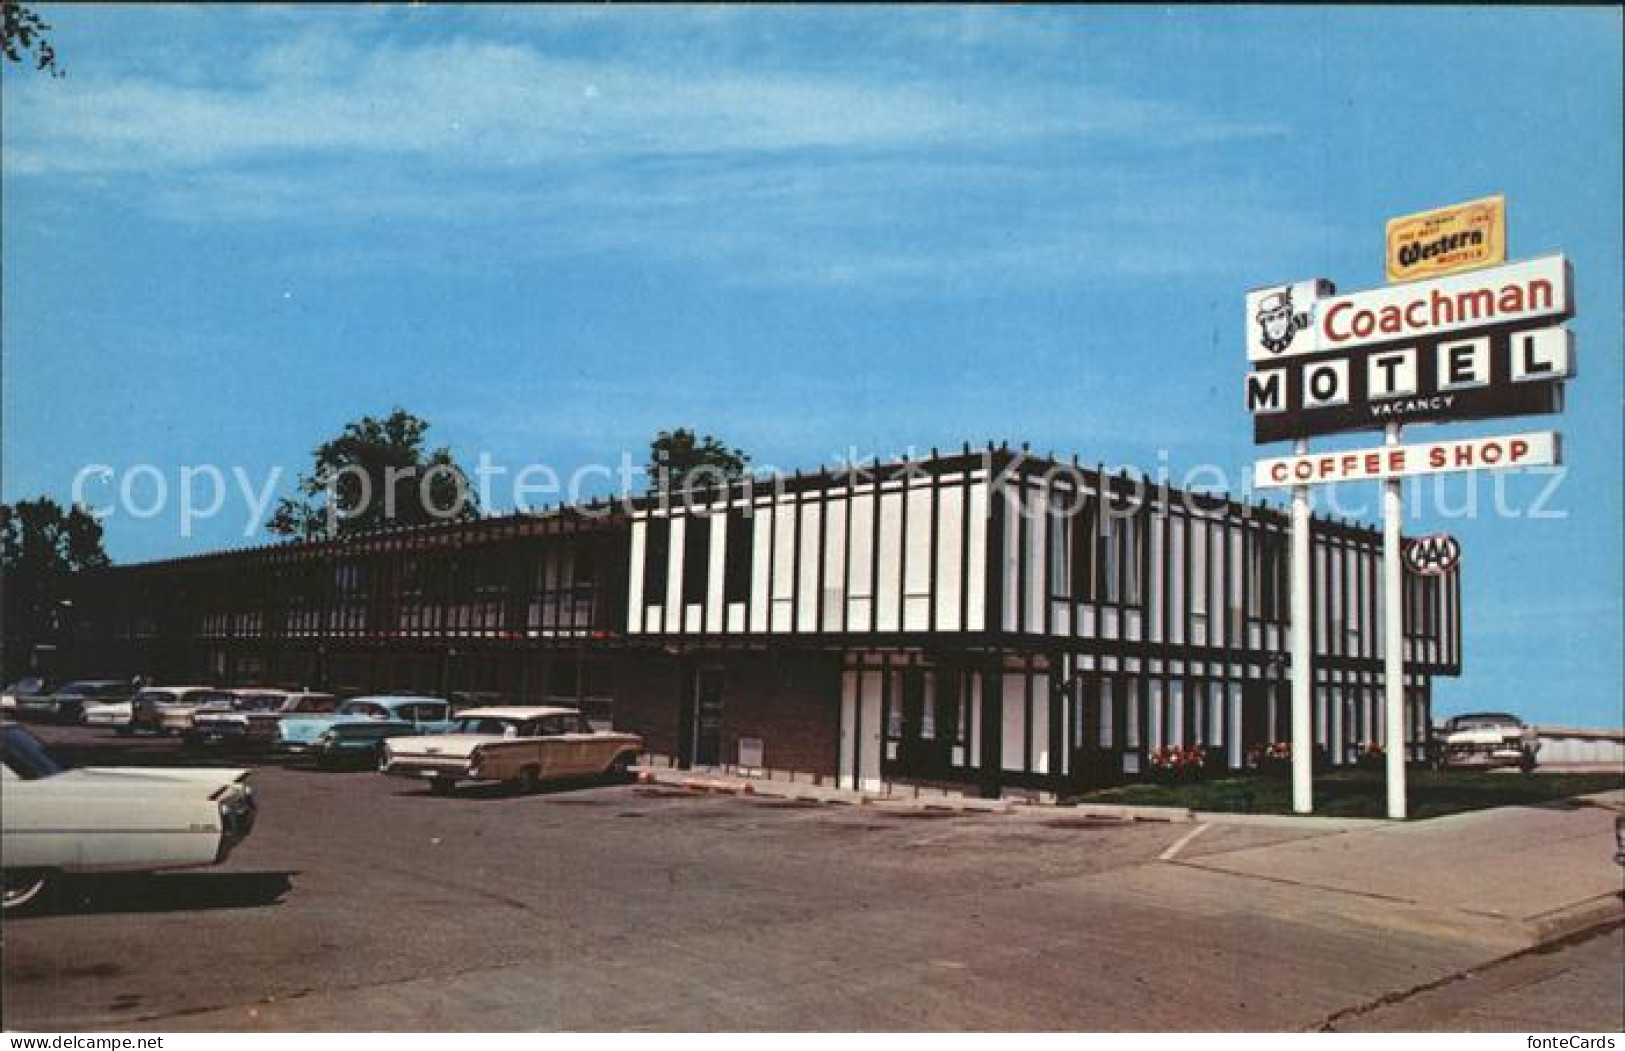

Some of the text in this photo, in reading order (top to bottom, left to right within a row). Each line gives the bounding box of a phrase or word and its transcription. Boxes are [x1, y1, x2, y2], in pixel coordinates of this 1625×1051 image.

[1399, 229, 1483, 268] Western
[1323, 278, 1553, 342] Coachman
[1248, 335, 1552, 412] MOTEL
[1370, 395, 1455, 416] VACANCY
[1271, 440, 1529, 482] COFFEE SHOP
